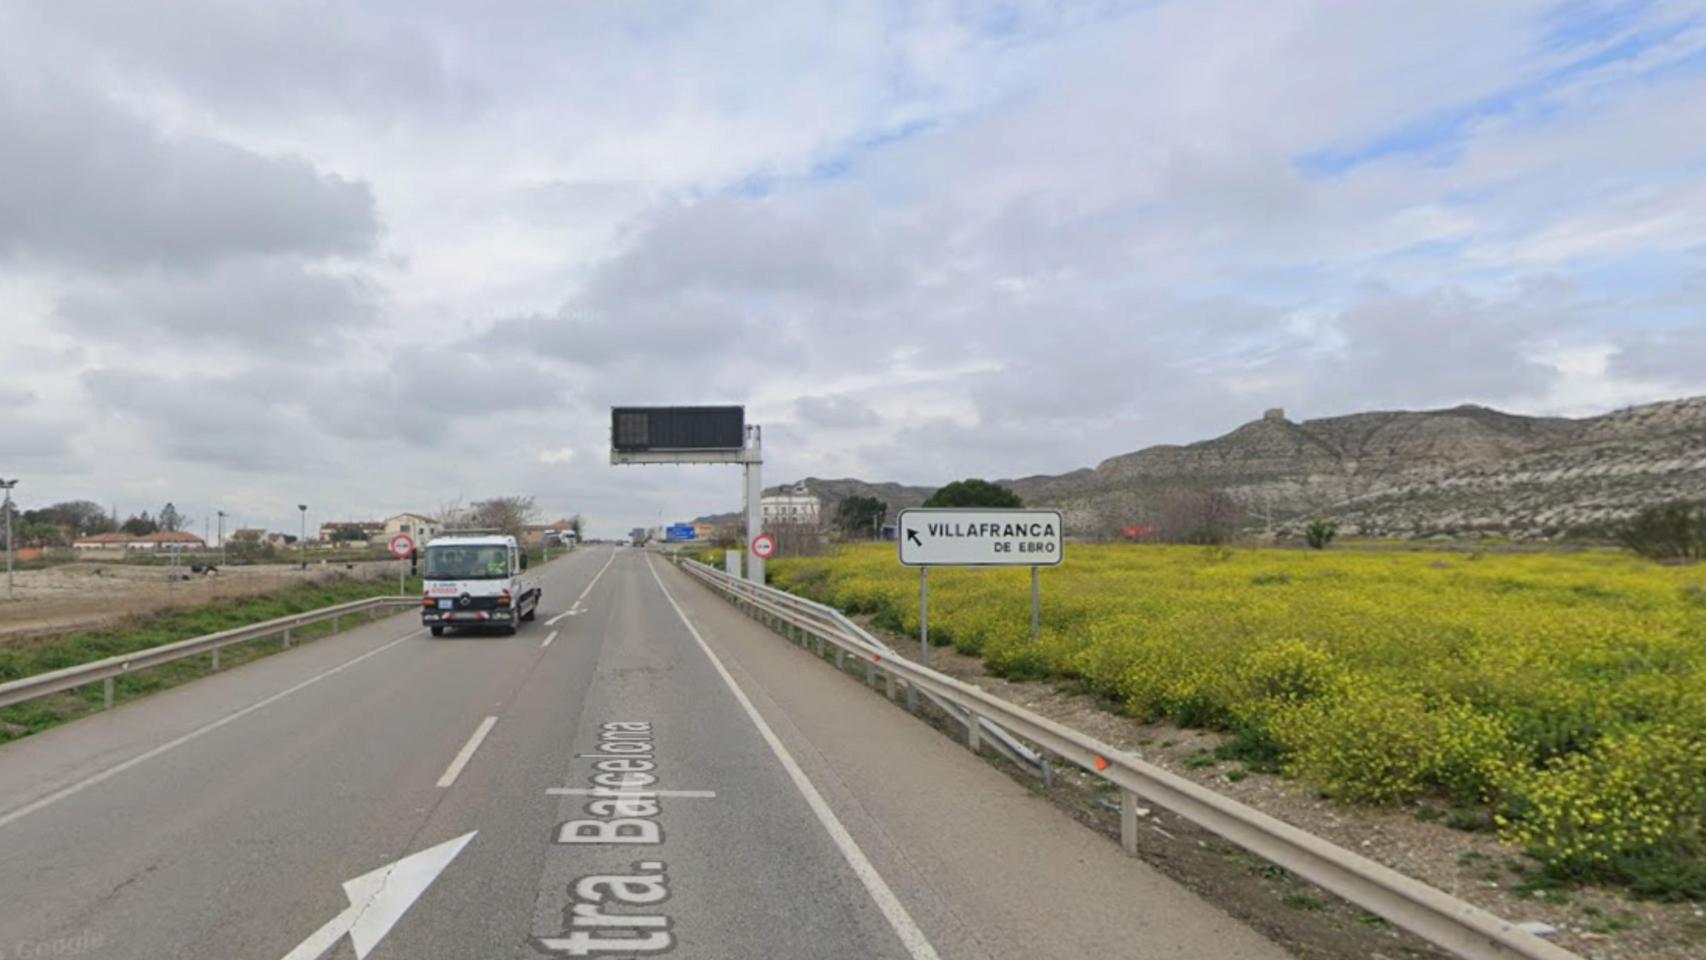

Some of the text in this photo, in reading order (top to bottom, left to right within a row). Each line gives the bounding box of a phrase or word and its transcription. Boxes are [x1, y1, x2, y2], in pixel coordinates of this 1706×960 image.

[928, 523, 1055, 537] VILLAFRANCA
[994, 542, 1055, 553] DE EBRO
